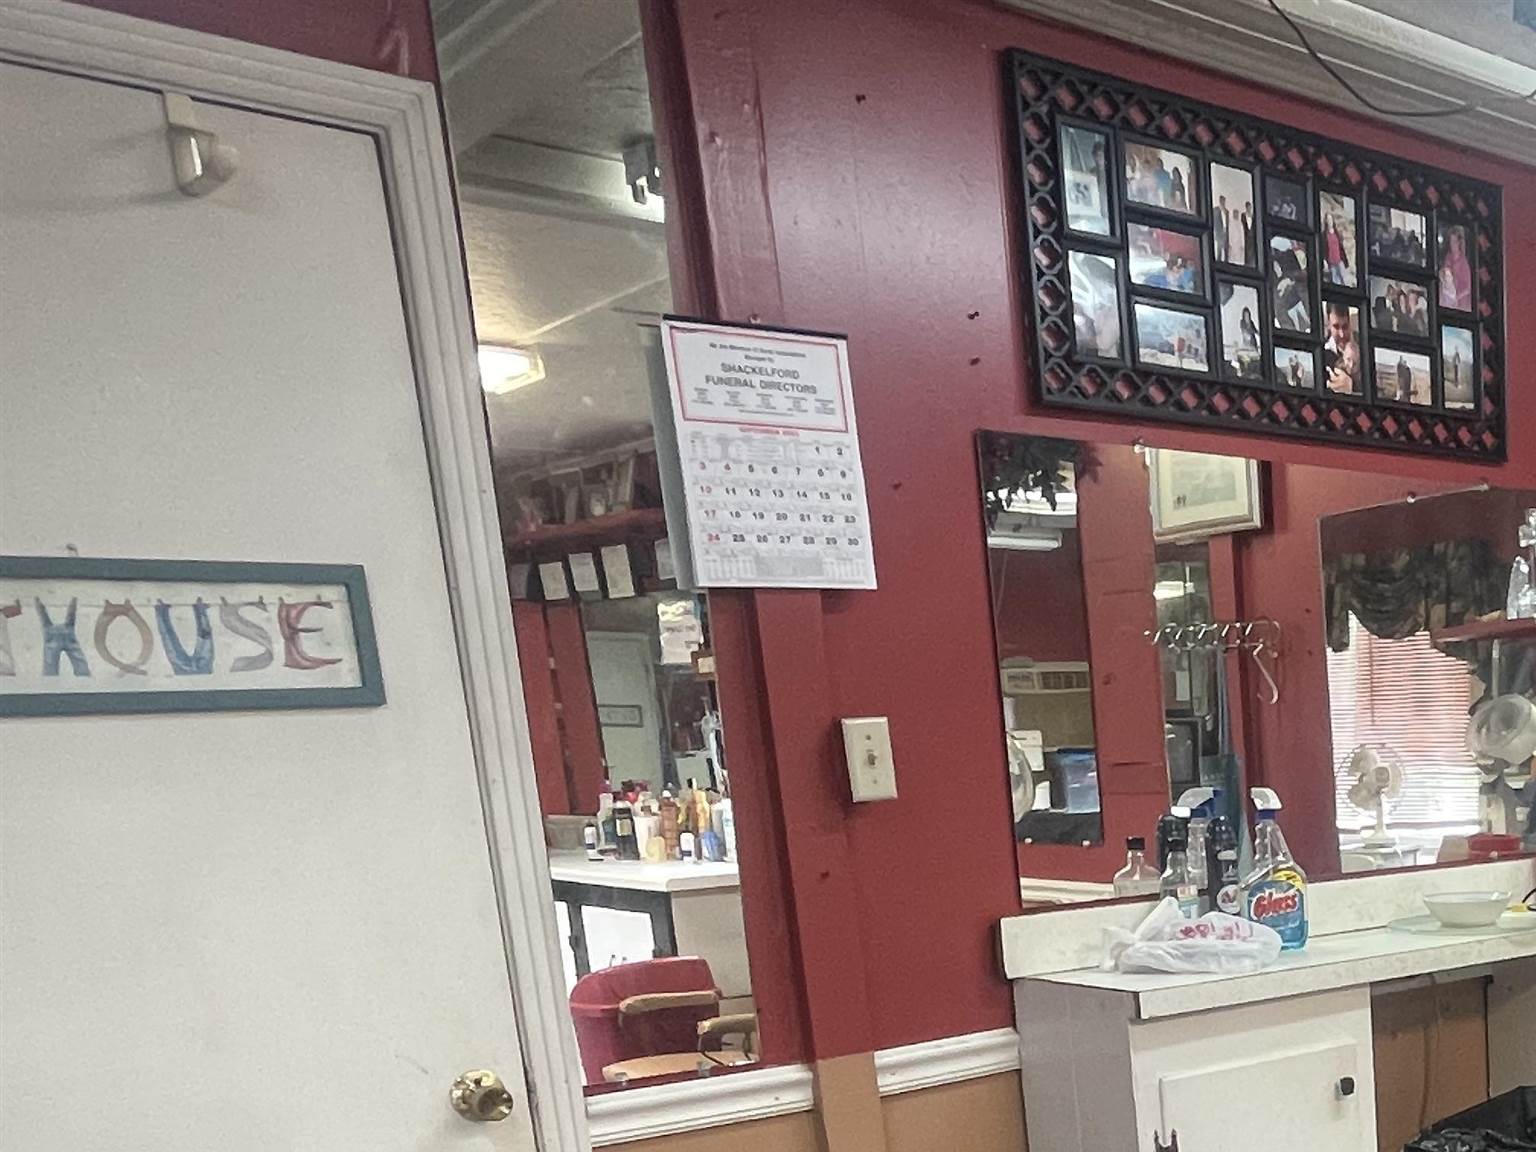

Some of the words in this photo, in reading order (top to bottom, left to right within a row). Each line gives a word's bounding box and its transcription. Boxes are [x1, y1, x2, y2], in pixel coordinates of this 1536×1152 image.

[720, 362, 800, 380] SHACKELFORD
[704, 375, 756, 389] FUNERAL
[759, 380, 817, 394] DIRECTORS
